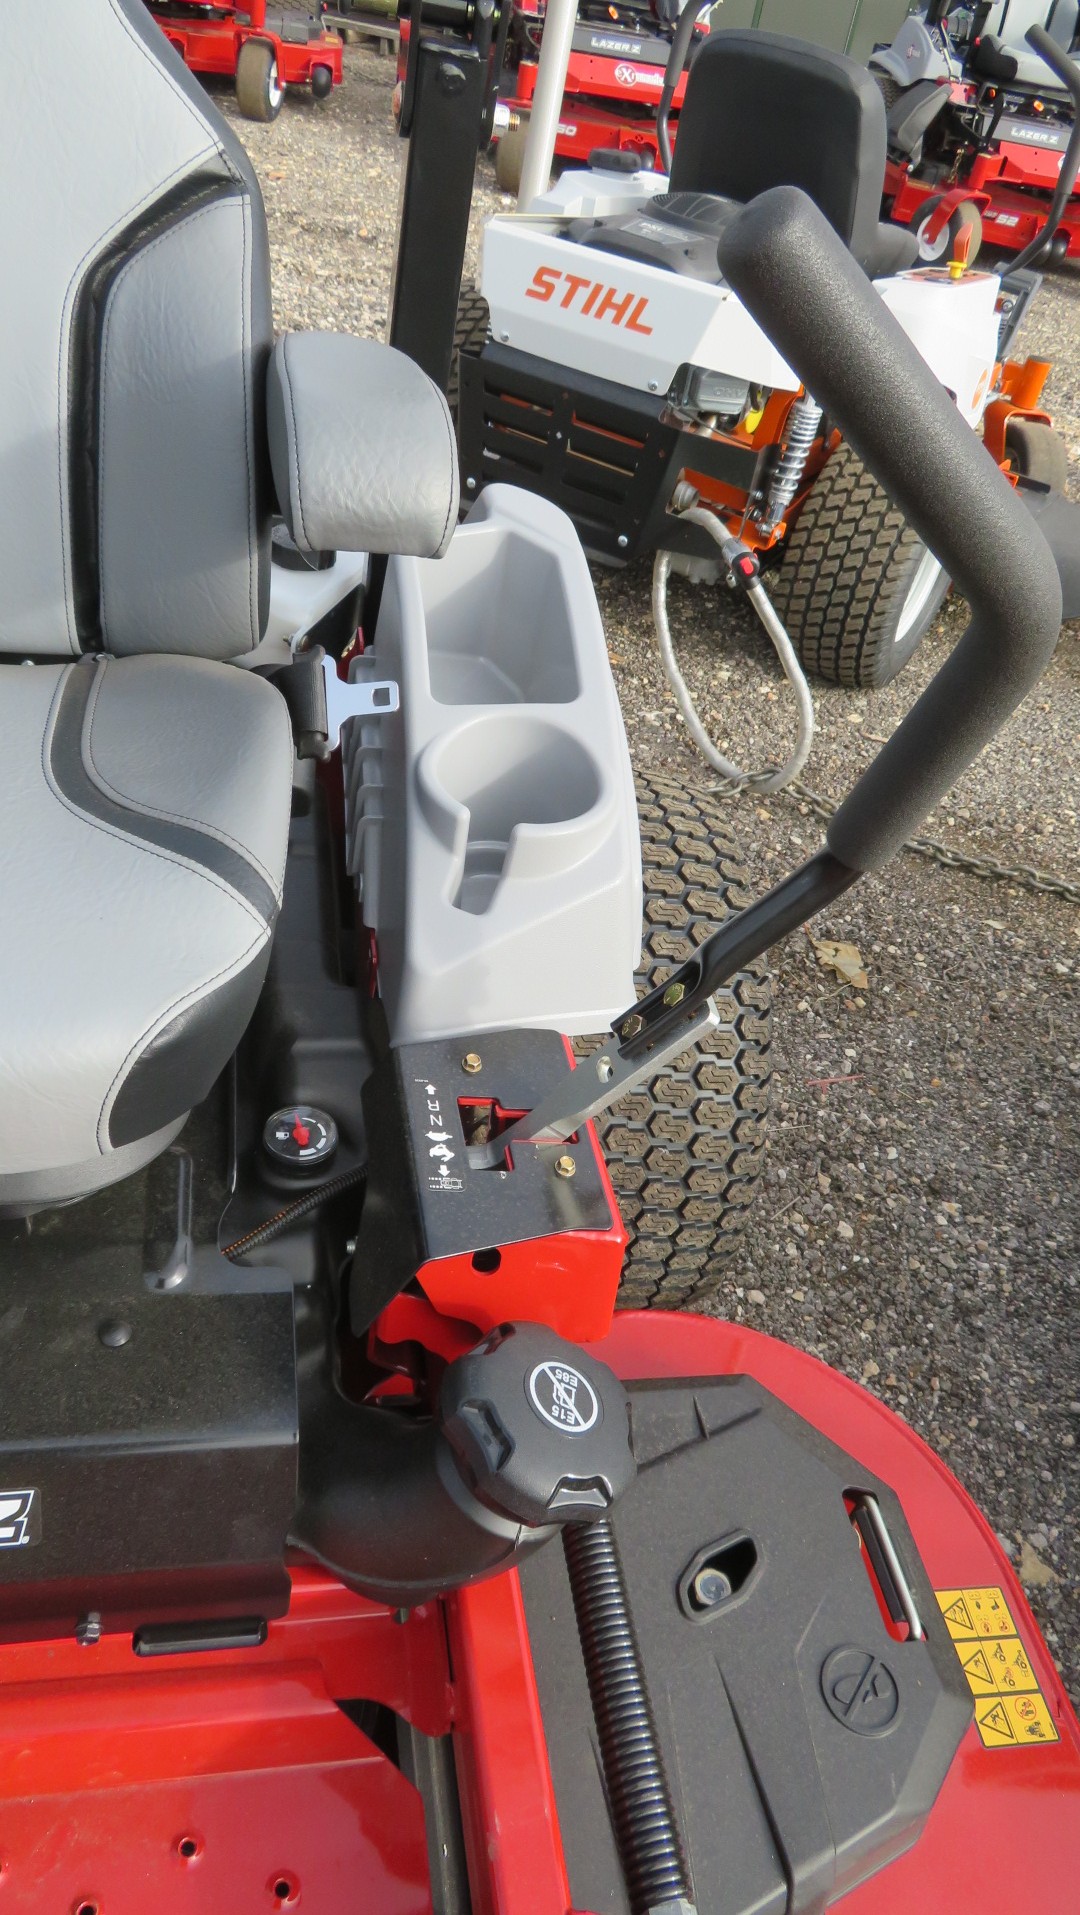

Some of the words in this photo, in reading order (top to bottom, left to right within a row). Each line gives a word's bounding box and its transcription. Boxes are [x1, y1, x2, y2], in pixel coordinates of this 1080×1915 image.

[590, 37, 630, 53] LAZER
[630, 44, 641, 55] Z
[1011, 126, 1047, 142] LAZER
[1048, 135, 1058, 145] Z
[525, 266, 653, 336] STIHL
[427, 1099, 440, 1112] R
[430, 1114, 443, 1127] N
[555, 1368, 578, 1387] E85
[551, 1404, 577, 1425] E15
